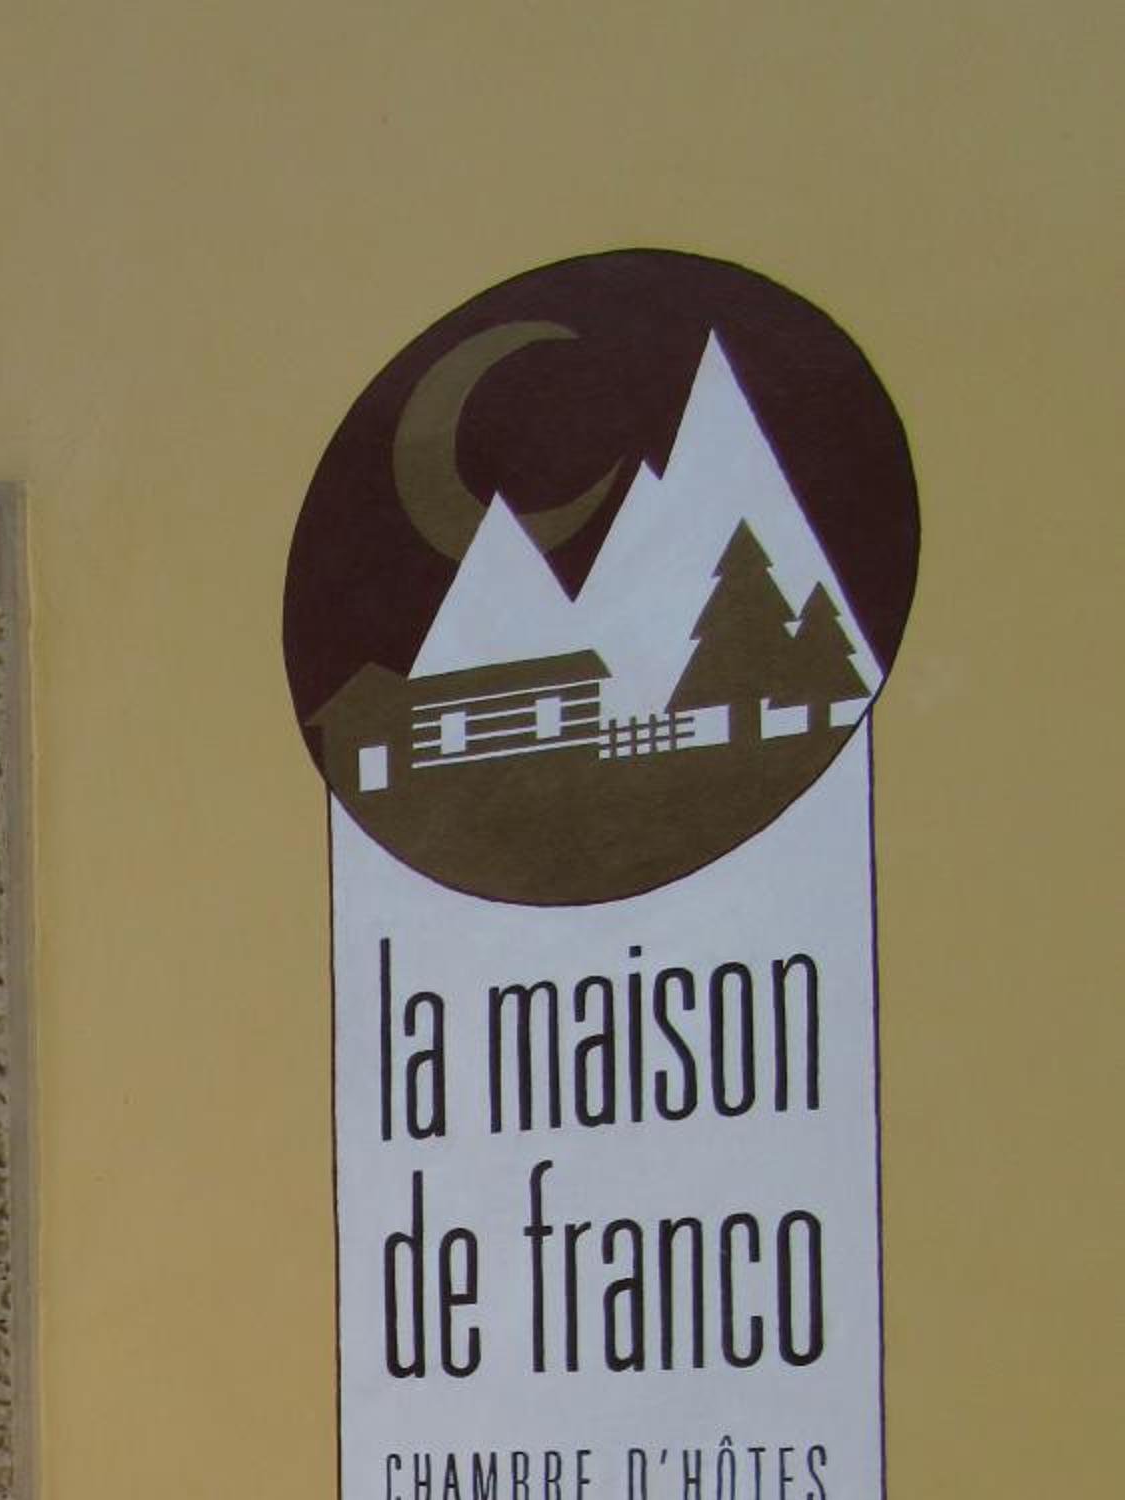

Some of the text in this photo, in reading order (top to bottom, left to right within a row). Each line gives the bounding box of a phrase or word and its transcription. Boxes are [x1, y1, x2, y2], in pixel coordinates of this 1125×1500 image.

[380, 937, 820, 1141] la maison
[384, 1160, 824, 1379] de franco
